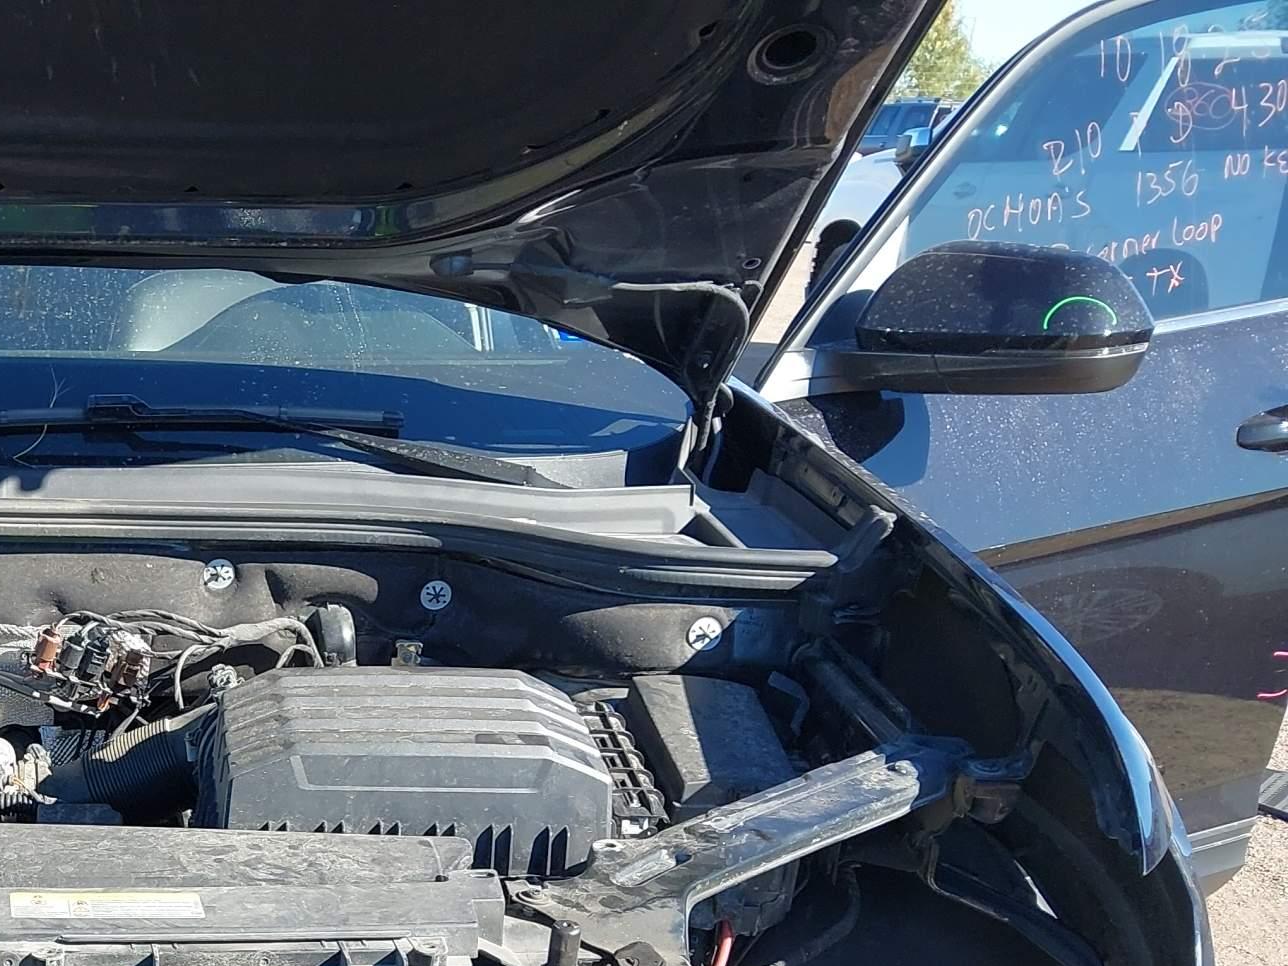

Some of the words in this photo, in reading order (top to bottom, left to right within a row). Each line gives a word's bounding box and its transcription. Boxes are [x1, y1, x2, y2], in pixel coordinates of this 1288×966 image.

[1100, 36, 1132, 82] 10
[968, 187, 1091, 240] OCHOA'S
[1137, 160, 1199, 208] 1356
